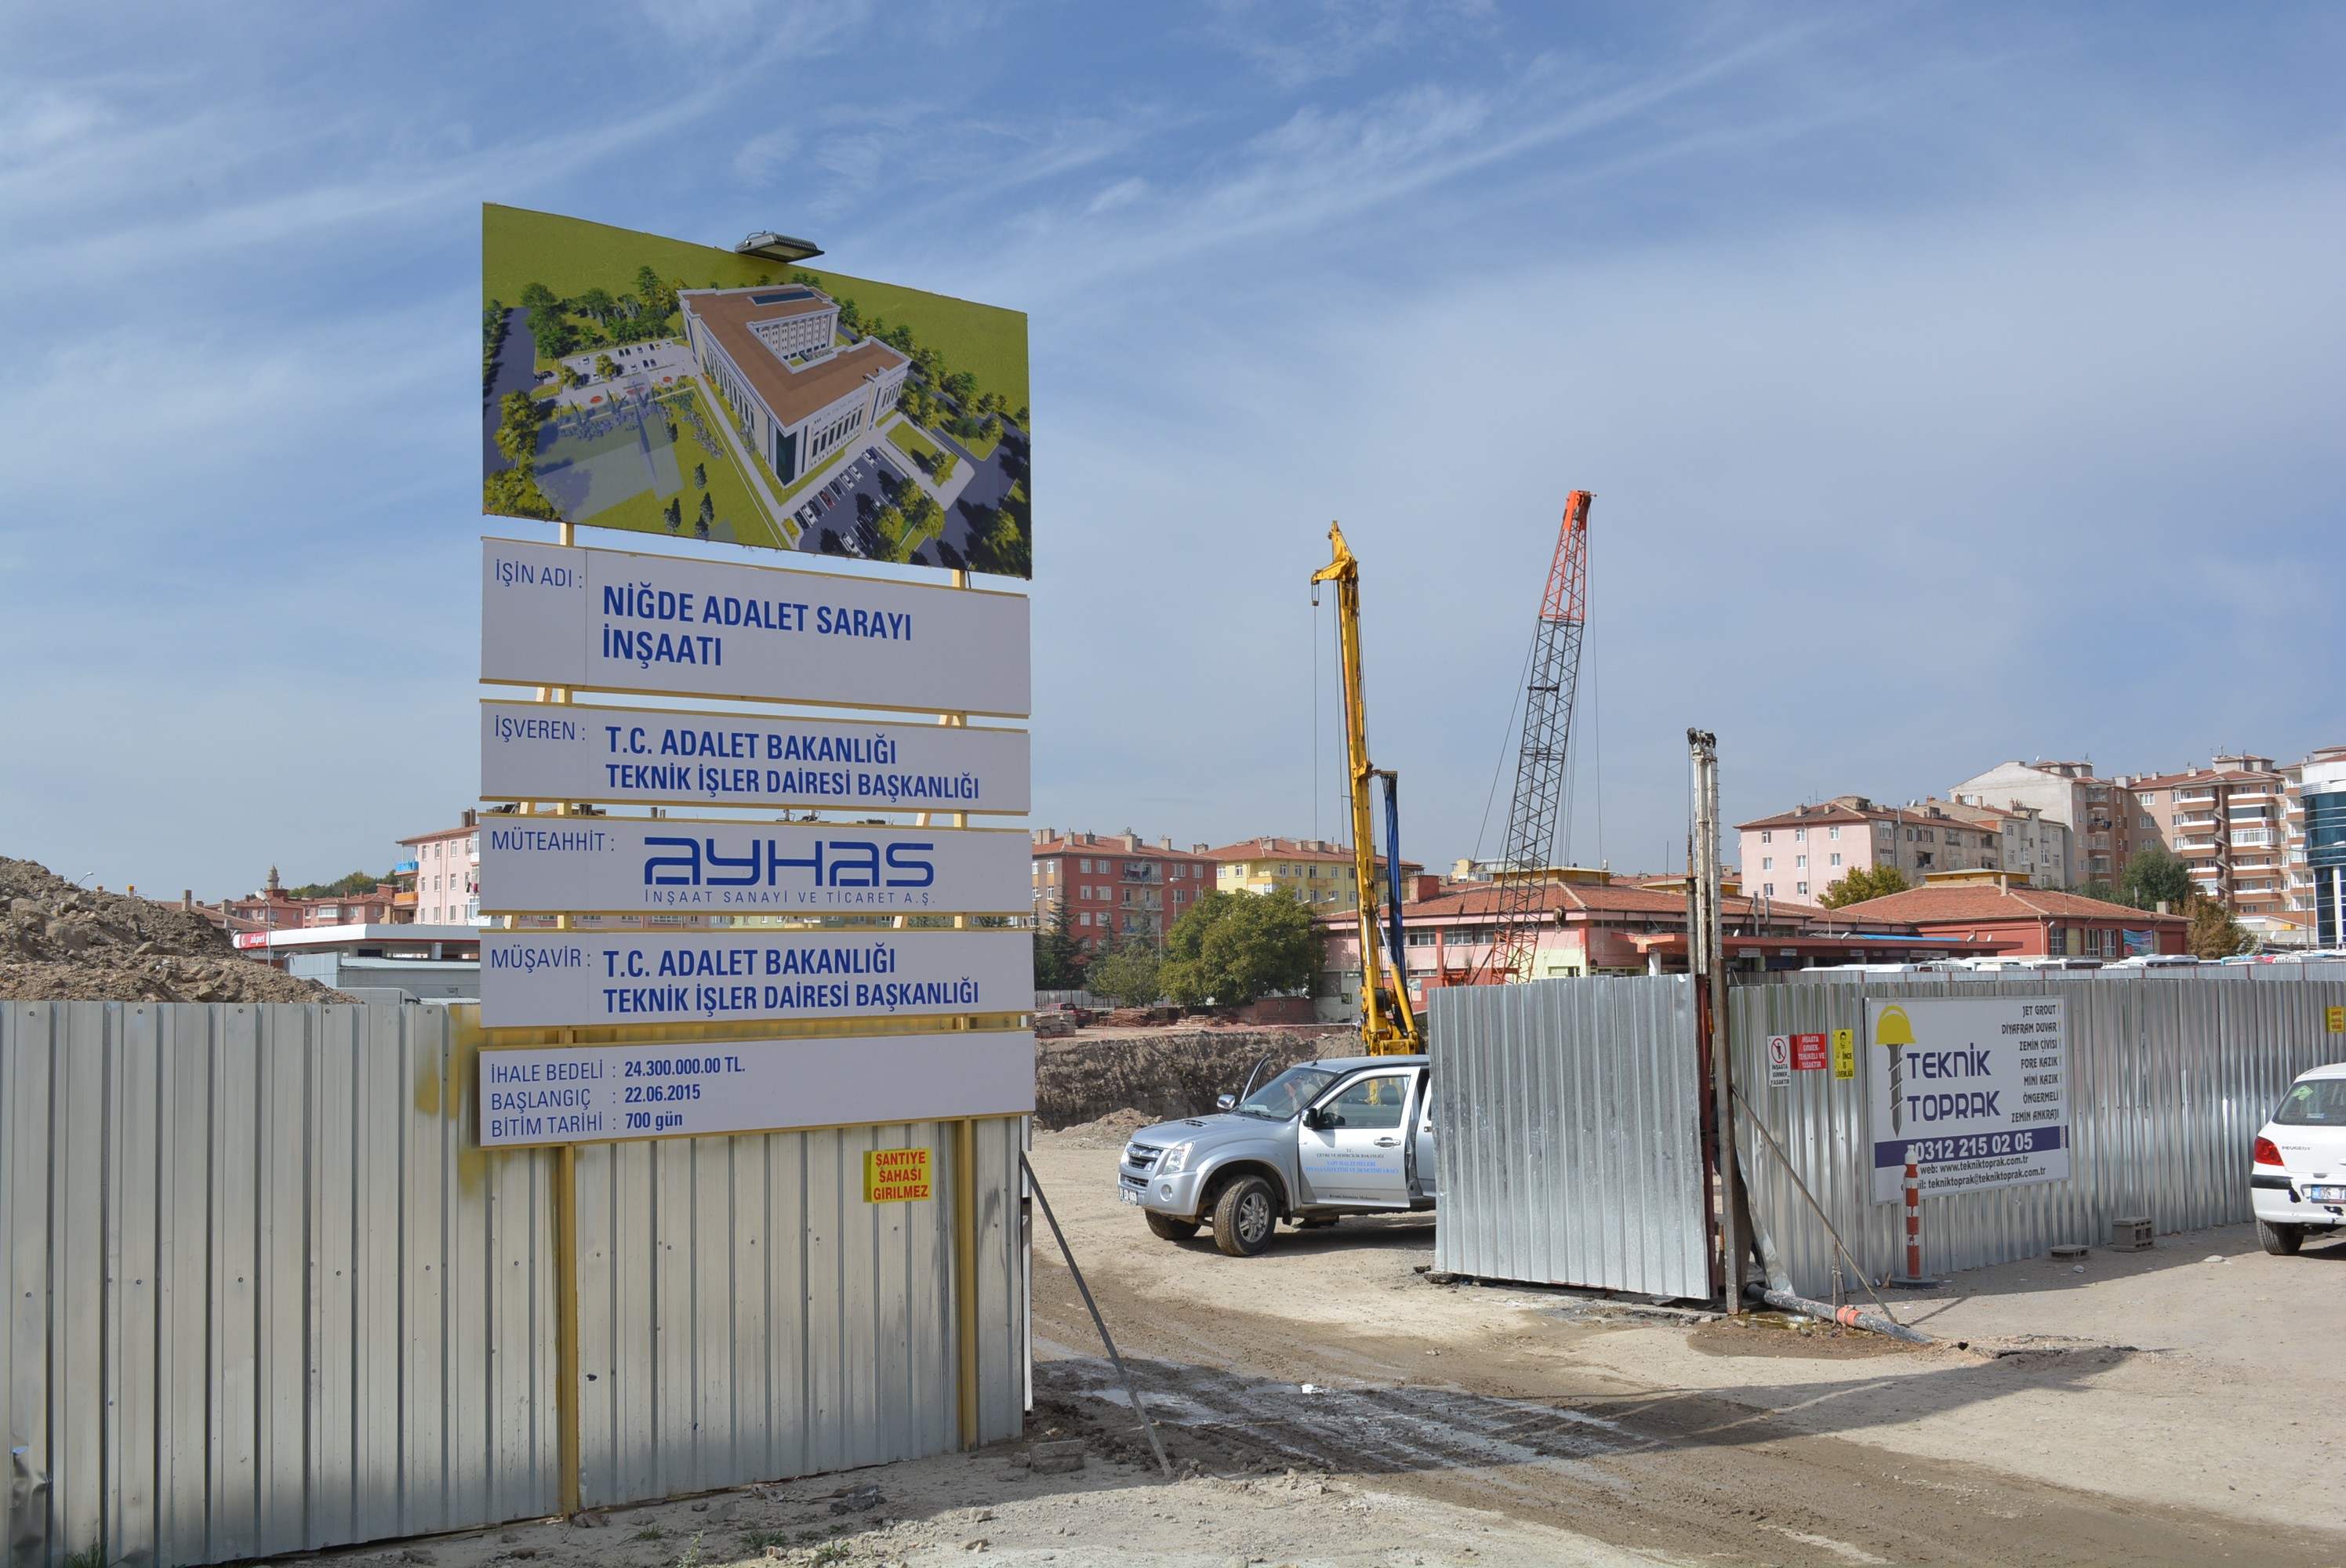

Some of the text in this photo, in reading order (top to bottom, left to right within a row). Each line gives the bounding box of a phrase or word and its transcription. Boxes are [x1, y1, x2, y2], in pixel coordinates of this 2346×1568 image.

[497, 559, 533, 586] İŞİN
[541, 568, 571, 587] ADI
[605, 582, 910, 641] NİĞDE ADALET SARAYI
[604, 623, 721, 669] İNŞAATI
[496, 715, 574, 742] İŞVEREN
[605, 727, 895, 764] T.C. ADALET BAKANLIĞI
[606, 763, 978, 802] TEKNİK İŞLER DAİRESİ BAŞKANLIĞI
[492, 830, 605, 851] MÜTEAHHİT
[646, 889, 935, 906] İNŞAAT SANAYİ VE TİCARET A.Ş.
[492, 945, 580, 973] MÜŞAVİR
[603, 942, 894, 977] T.C. ADALET BAKANLIĞI
[603, 977, 978, 1017] TEKNİK İŞLER DAİRESİ BAŞKANLIĞI
[2023, 1005, 2056, 1018] JET GROUT
[2002, 1022, 2057, 1034] DİYAFRAM DUVAR
[2020, 1037, 2057, 1052] ZEMİN ÇİVİSİ
[492, 1064, 539, 1083] İHALE
[547, 1059, 602, 1080] BEDELİ
[625, 1058, 720, 1076] 24.300.000.00
[724, 1057, 745, 1072] TL.
[2021, 1057, 2057, 1069] FORE KAZIK
[2024, 1074, 2058, 1086] MİNİ KAZIK
[492, 1089, 590, 1113] BAŞLANGIÇ
[625, 1084, 700, 1102] 22.06.2015
[1907, 1091, 2000, 1121] TOPRAK
[2023, 1091, 2058, 1104] ÖNGERMELİ
[492, 1116, 541, 1137] BİTİM
[547, 1112, 601, 1133] TARİHİ
[626, 1112, 650, 1128] 700
[656, 1111, 682, 1131] gün
[2012, 1109, 2058, 1123] ZEMİN ANKRAJI
[1915, 1132, 2032, 1160] 0312 215 02 05
[879, 1168, 921, 1183] SAHASI
[1920, 1155, 2028, 1174] web: www.tekniktoprak.com.tr
[1928, 1167, 2046, 1189] tekniktoprak@tekniktoprak.com.tr
